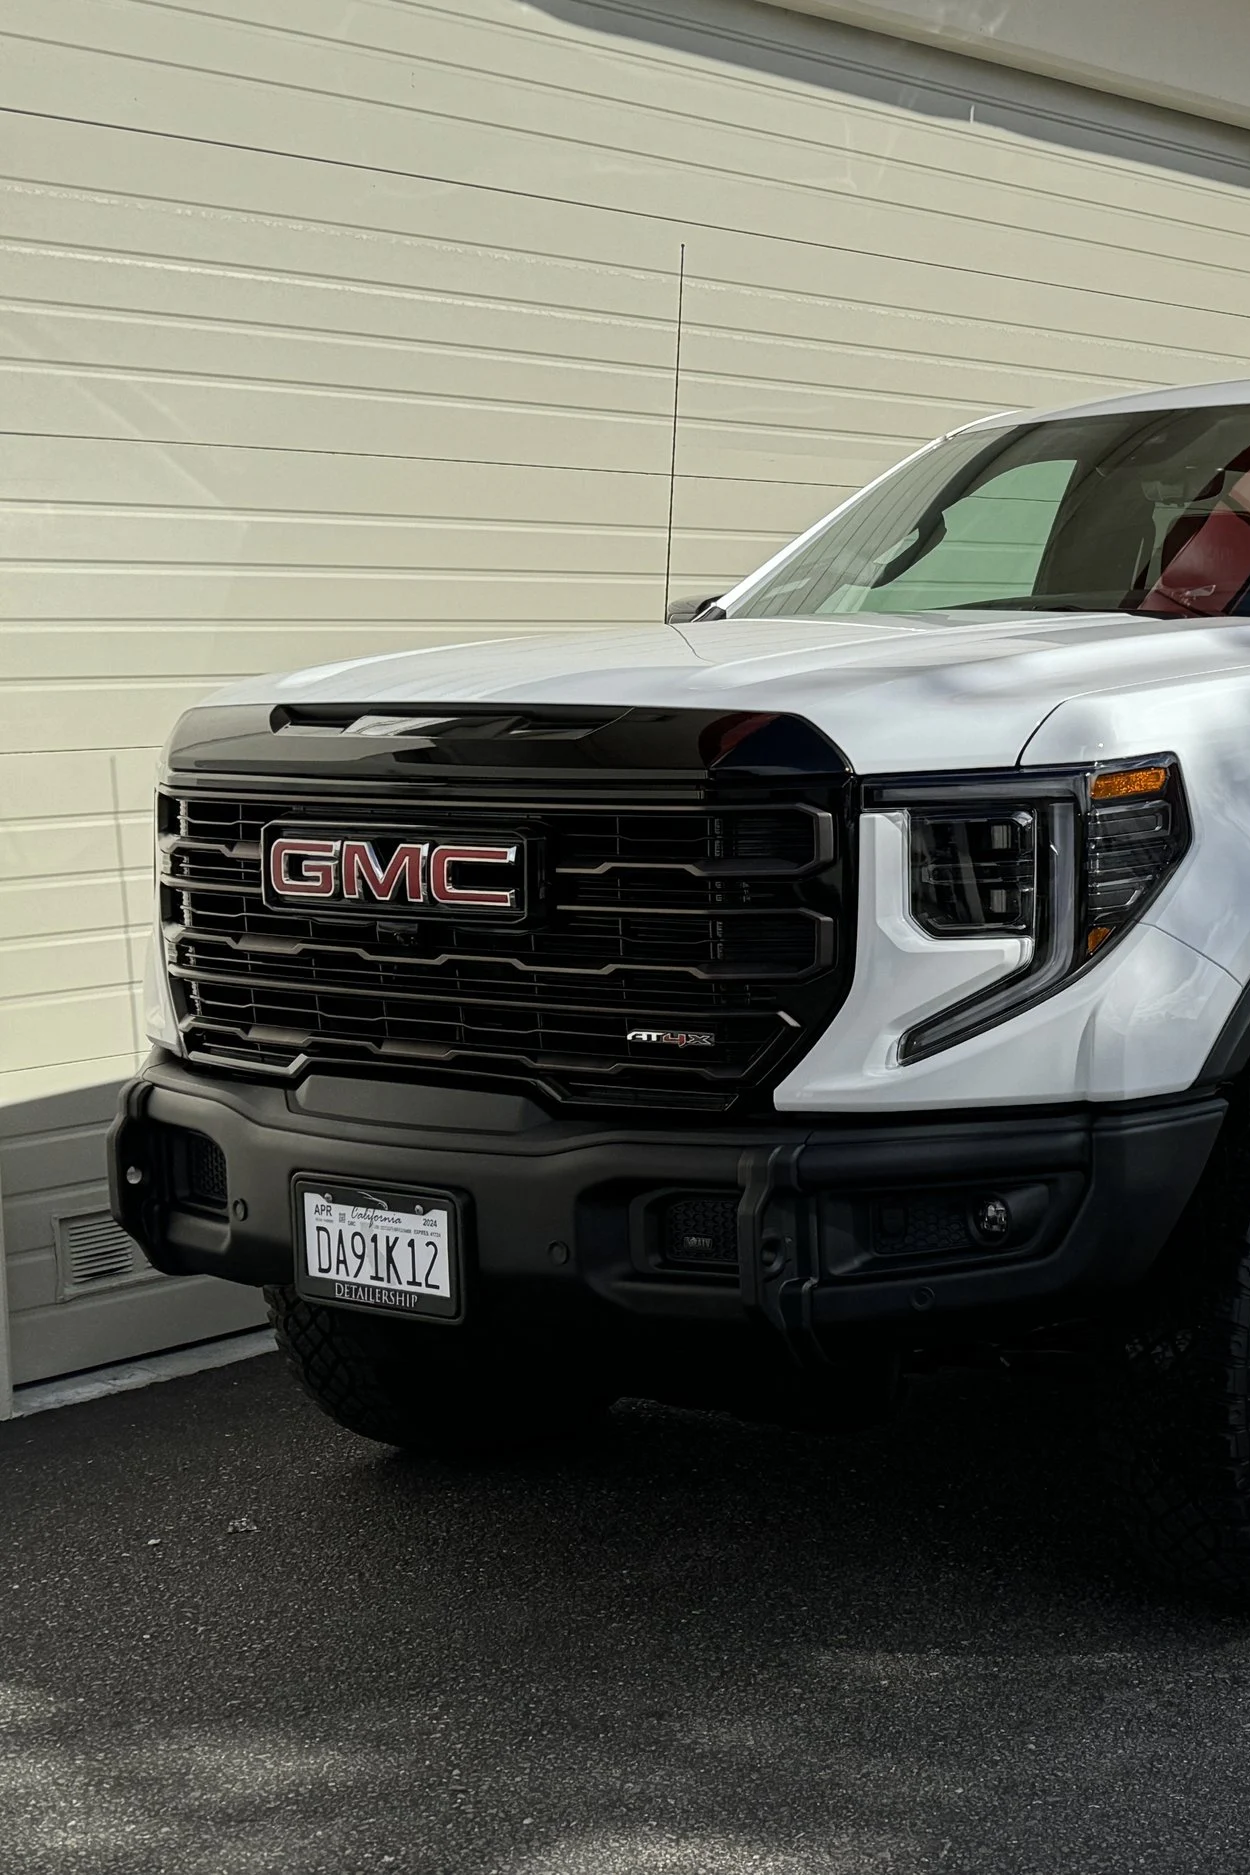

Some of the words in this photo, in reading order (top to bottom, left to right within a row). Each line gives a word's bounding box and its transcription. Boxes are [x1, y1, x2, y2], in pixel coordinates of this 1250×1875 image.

[270, 836, 518, 908] GMC
[626, 1030, 712, 1049] AT4X
[314, 1204, 333, 1217] APR
[350, 1206, 402, 1228] California
[422, 1218, 438, 1228] 2024
[316, 1226, 440, 1290] DA91K12
[335, 1282, 418, 1308] DETAILERSHIP
